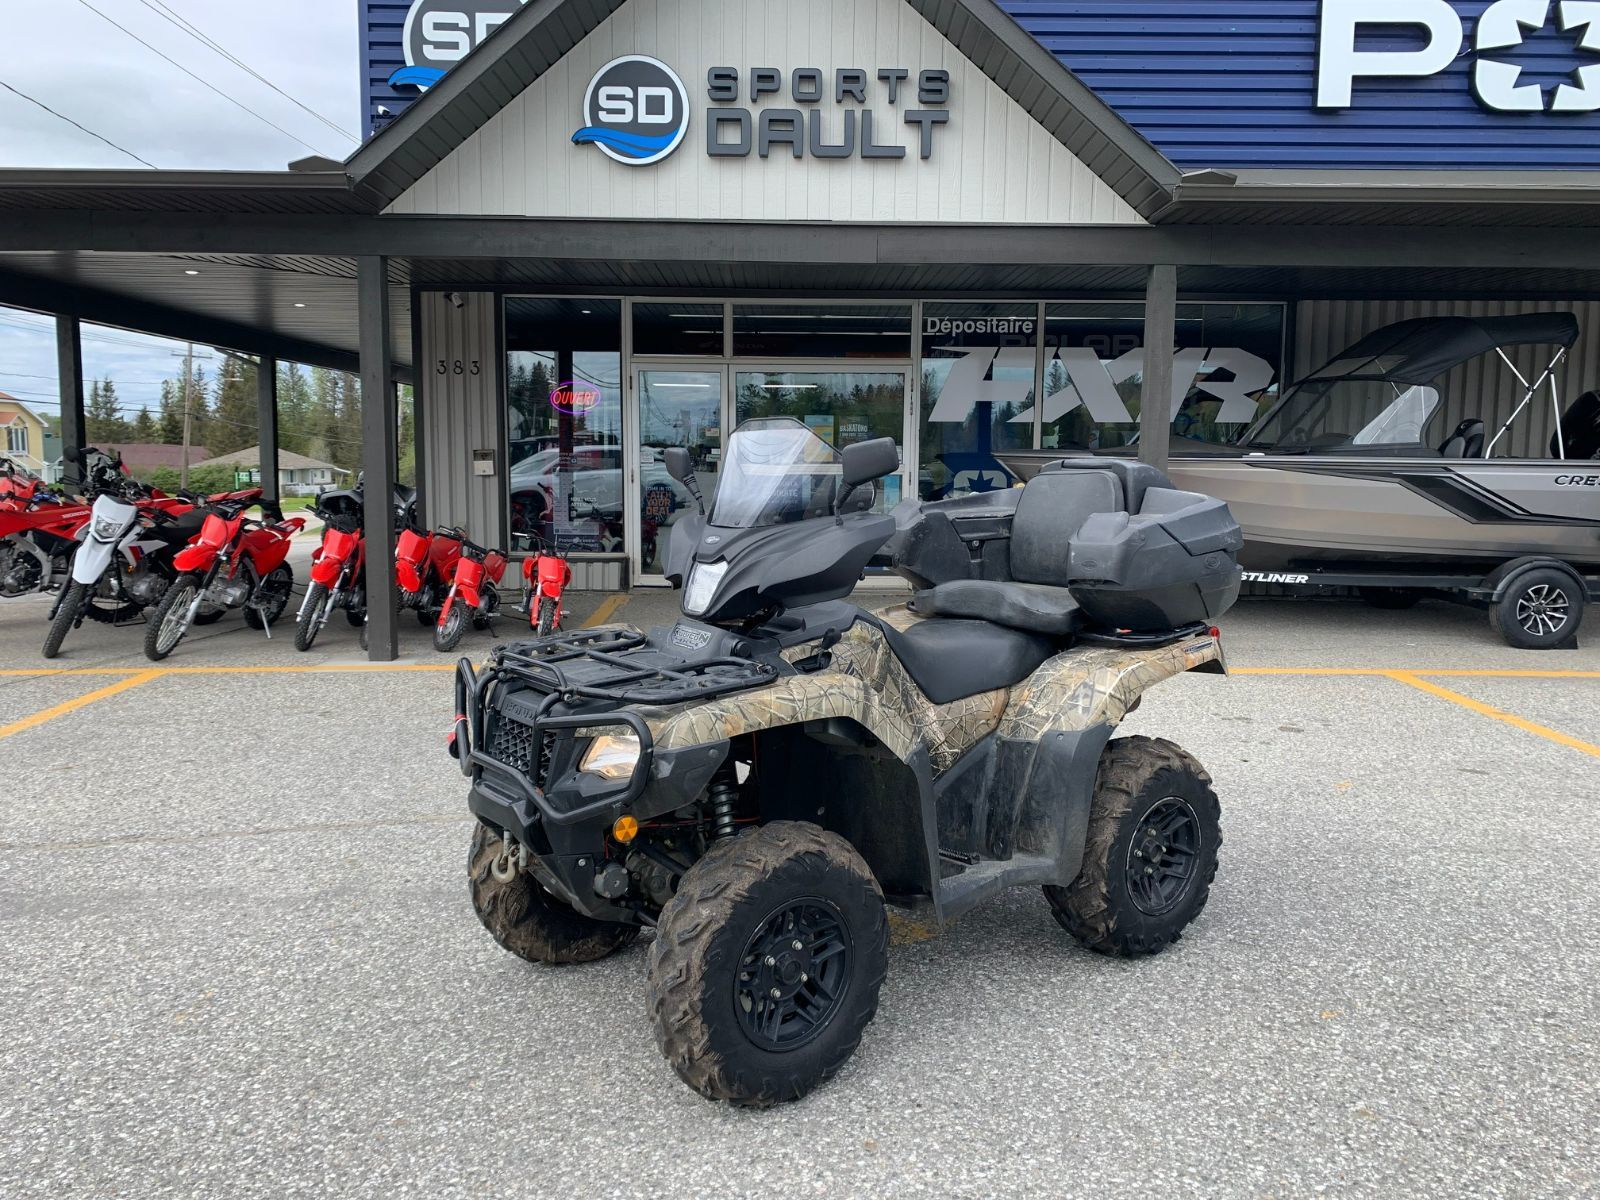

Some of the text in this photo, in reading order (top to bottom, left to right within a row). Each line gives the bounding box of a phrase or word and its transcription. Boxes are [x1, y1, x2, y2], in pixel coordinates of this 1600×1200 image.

[706, 66, 950, 105] SPORTS
[598, 86, 673, 124] SD
[706, 107, 950, 160] DAULT
[926, 316, 1034, 337] Dépositaire
[436, 360, 480, 375] 383
[553, 391, 598, 406] OUVERT
[1554, 475, 1600, 486] CRE
